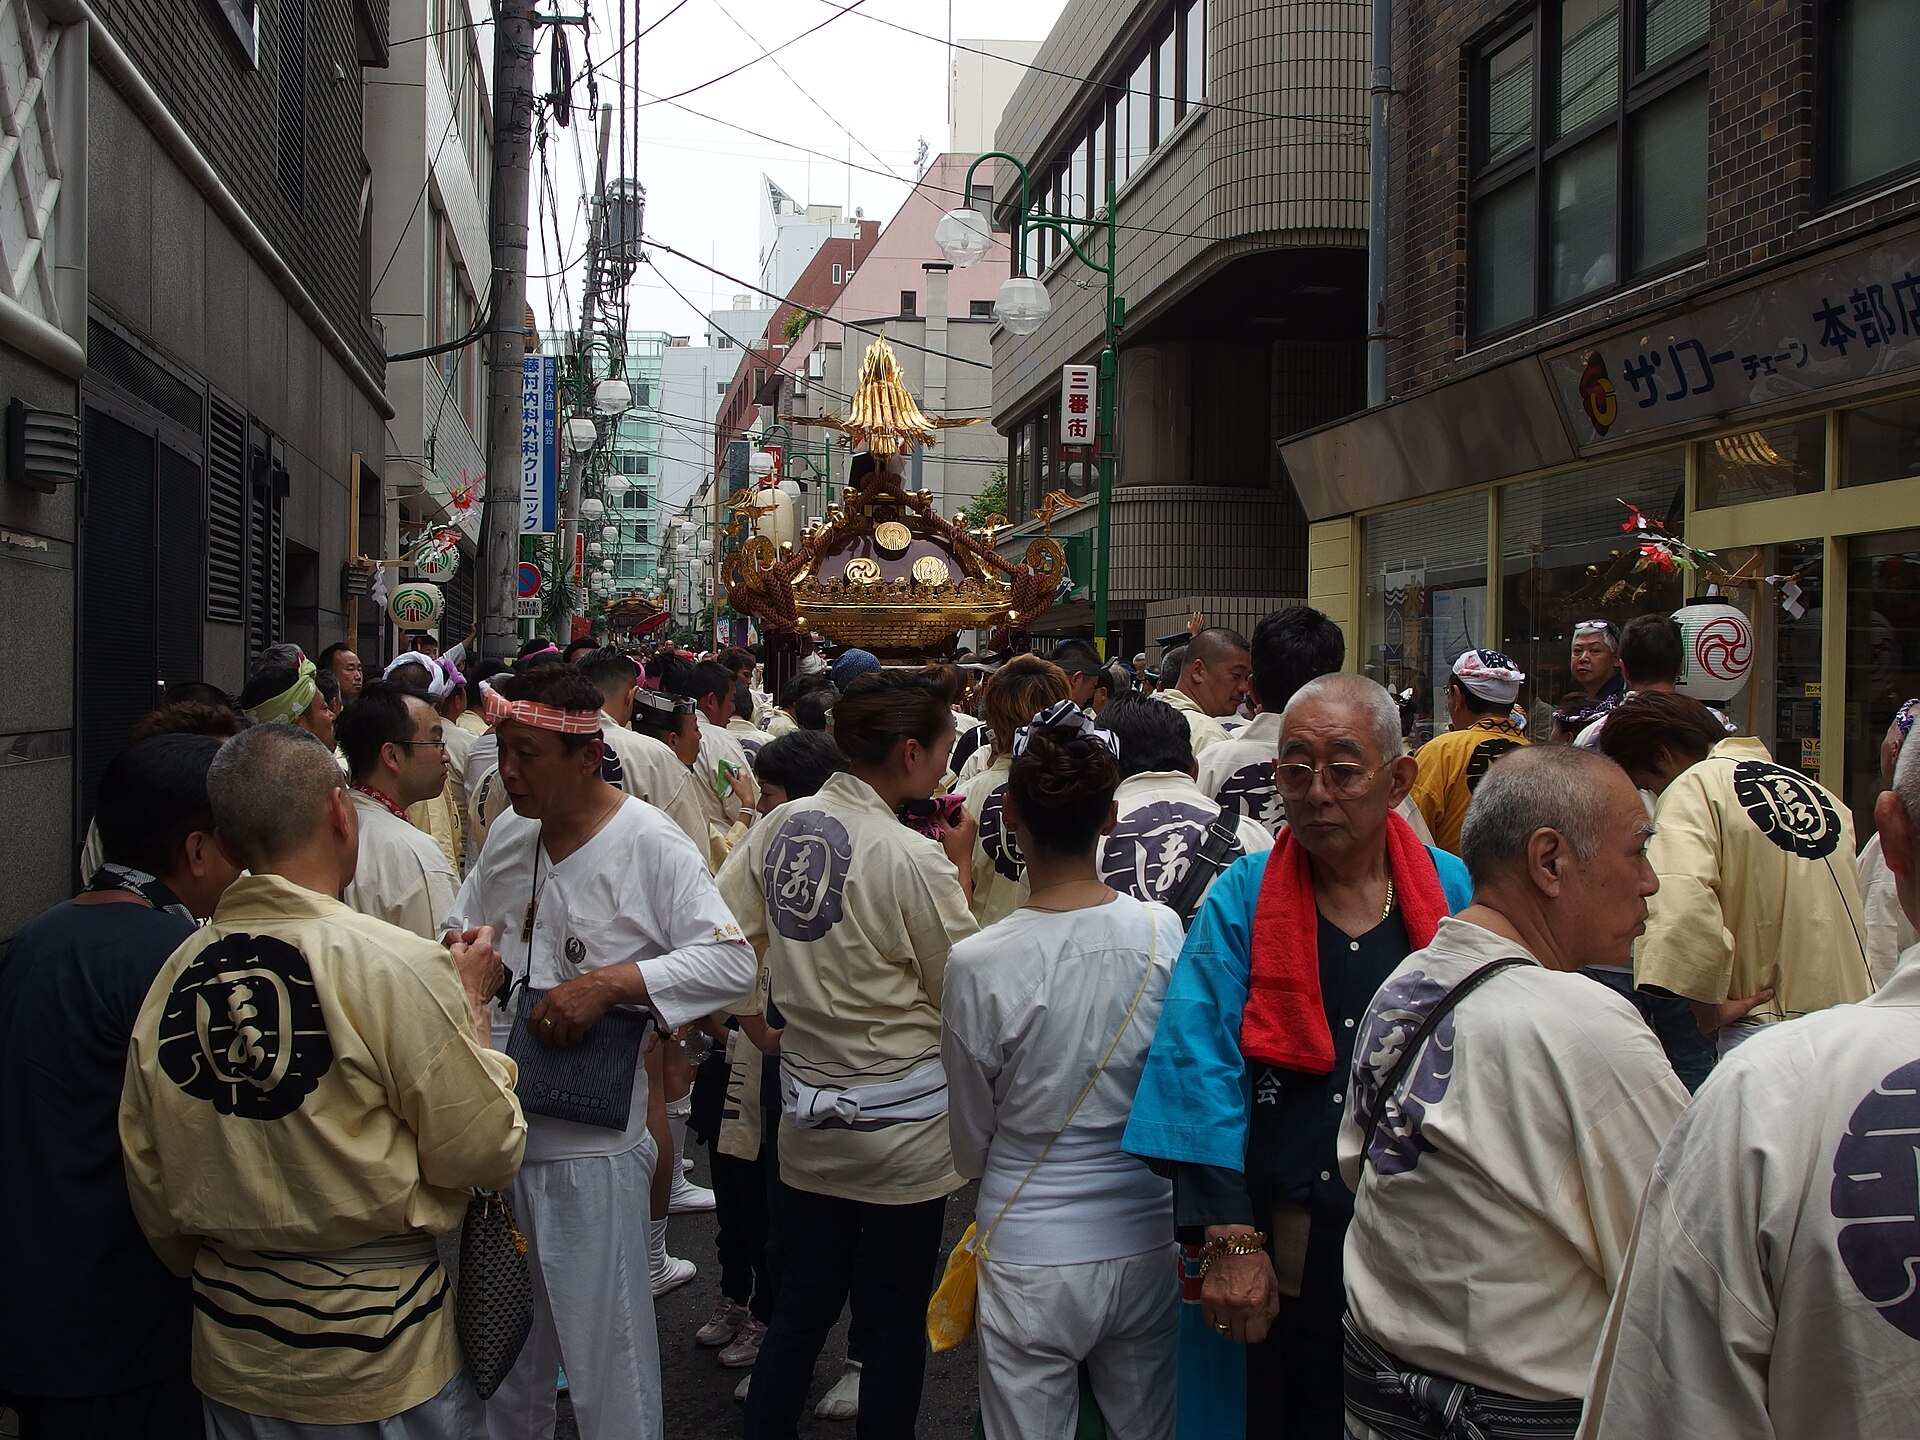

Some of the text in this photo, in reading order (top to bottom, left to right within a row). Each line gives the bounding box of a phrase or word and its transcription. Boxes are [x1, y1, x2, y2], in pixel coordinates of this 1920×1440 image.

[1741, 343, 1808, 380] チェーン
[1068, 371, 1089, 437] 三番街
[522, 357, 539, 529] 藤村内科外科クリニック
[545, 419, 554, 445] 和光会
[1256, 1067, 1281, 1105] 会
